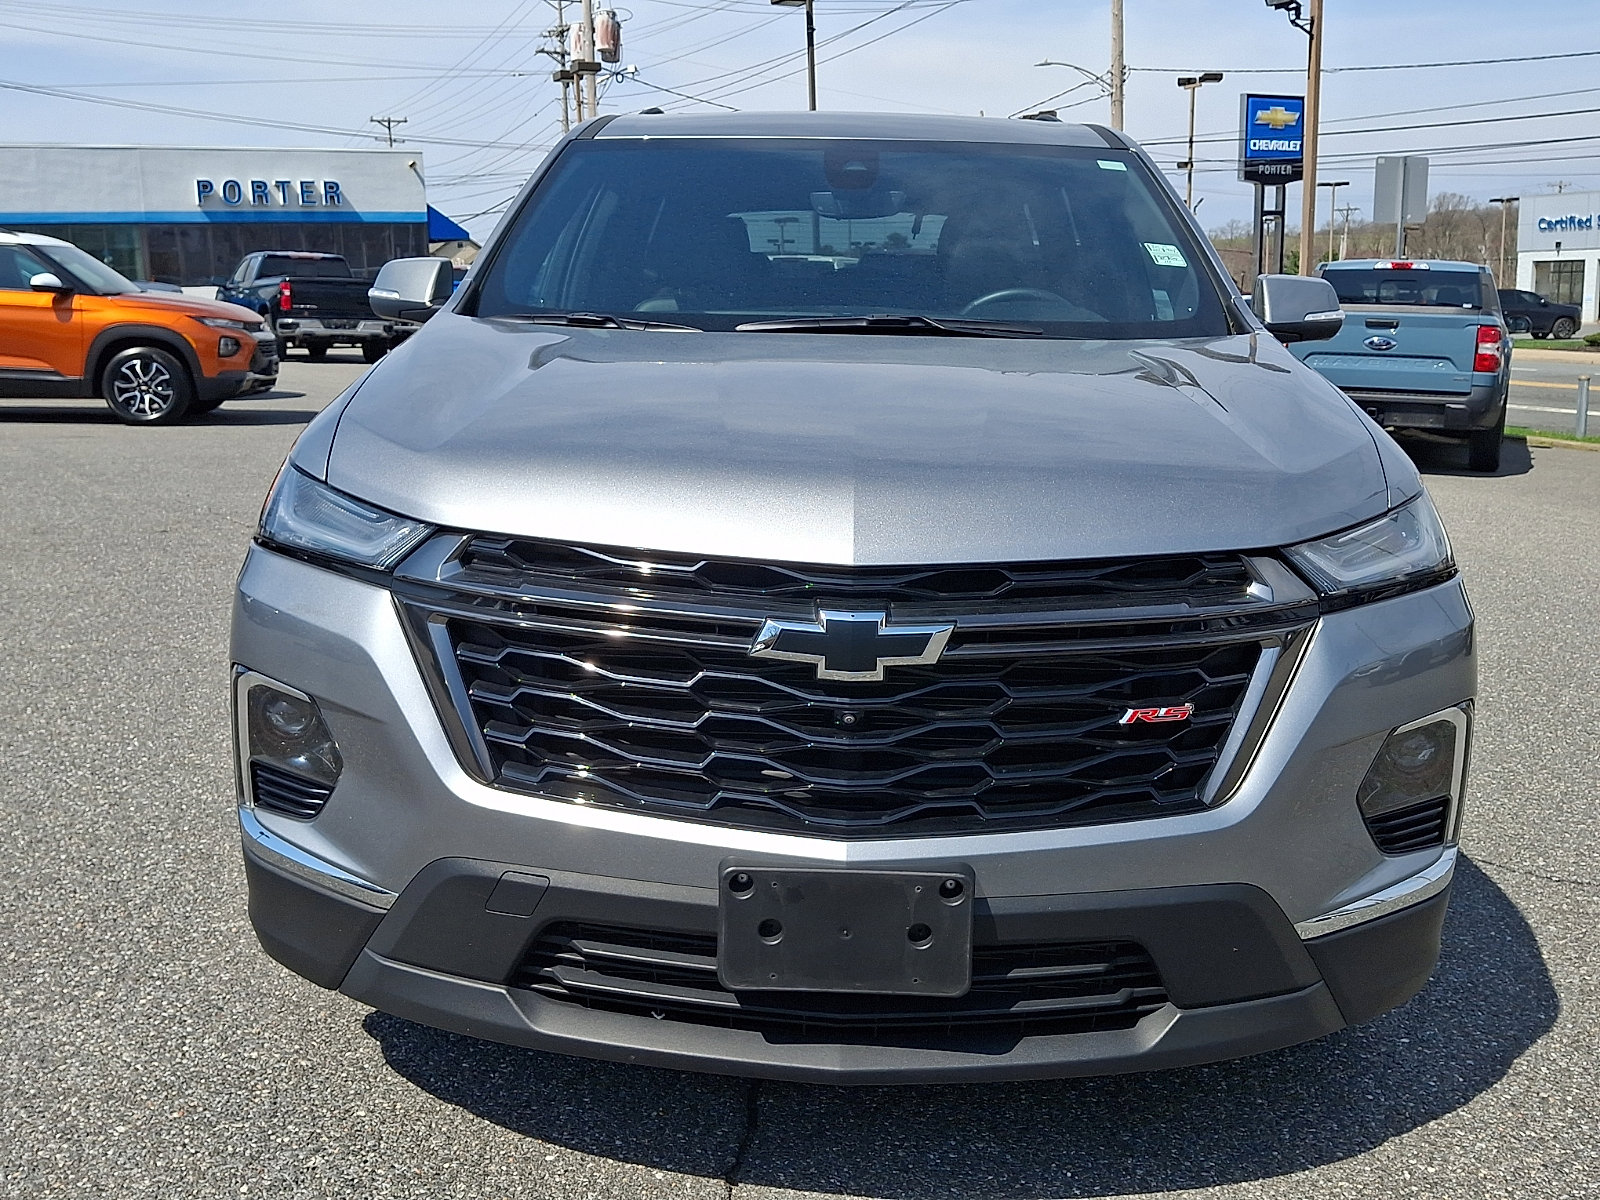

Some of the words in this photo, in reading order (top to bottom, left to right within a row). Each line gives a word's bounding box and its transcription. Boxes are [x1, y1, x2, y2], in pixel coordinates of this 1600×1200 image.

[1250, 140, 1301, 151] CHEVROLET
[1259, 165, 1292, 174] PORTER
[195, 179, 343, 206] PORTER
[1538, 215, 1592, 231] Certified
[1118, 703, 1194, 724] RS
